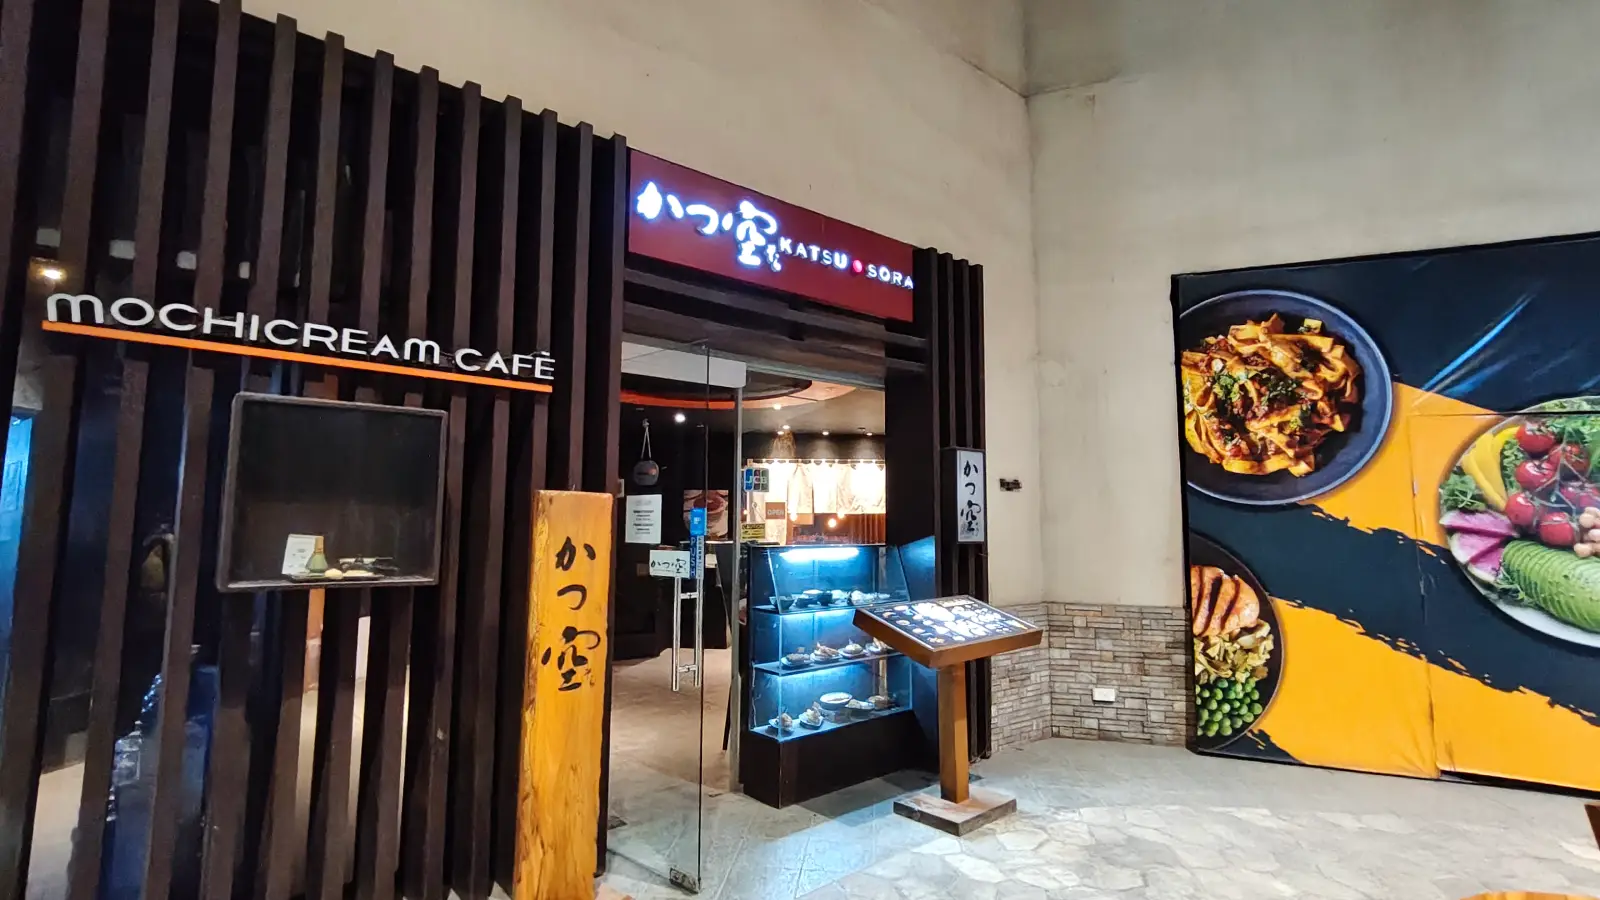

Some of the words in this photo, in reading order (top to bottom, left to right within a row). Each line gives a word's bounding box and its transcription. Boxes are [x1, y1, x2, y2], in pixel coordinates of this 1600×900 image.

[779, 236, 849, 271] KATSU
[867, 264, 914, 291] SORA
[46, 292, 441, 365] MOCHICREAM
[744, 475, 768, 485] JCB
